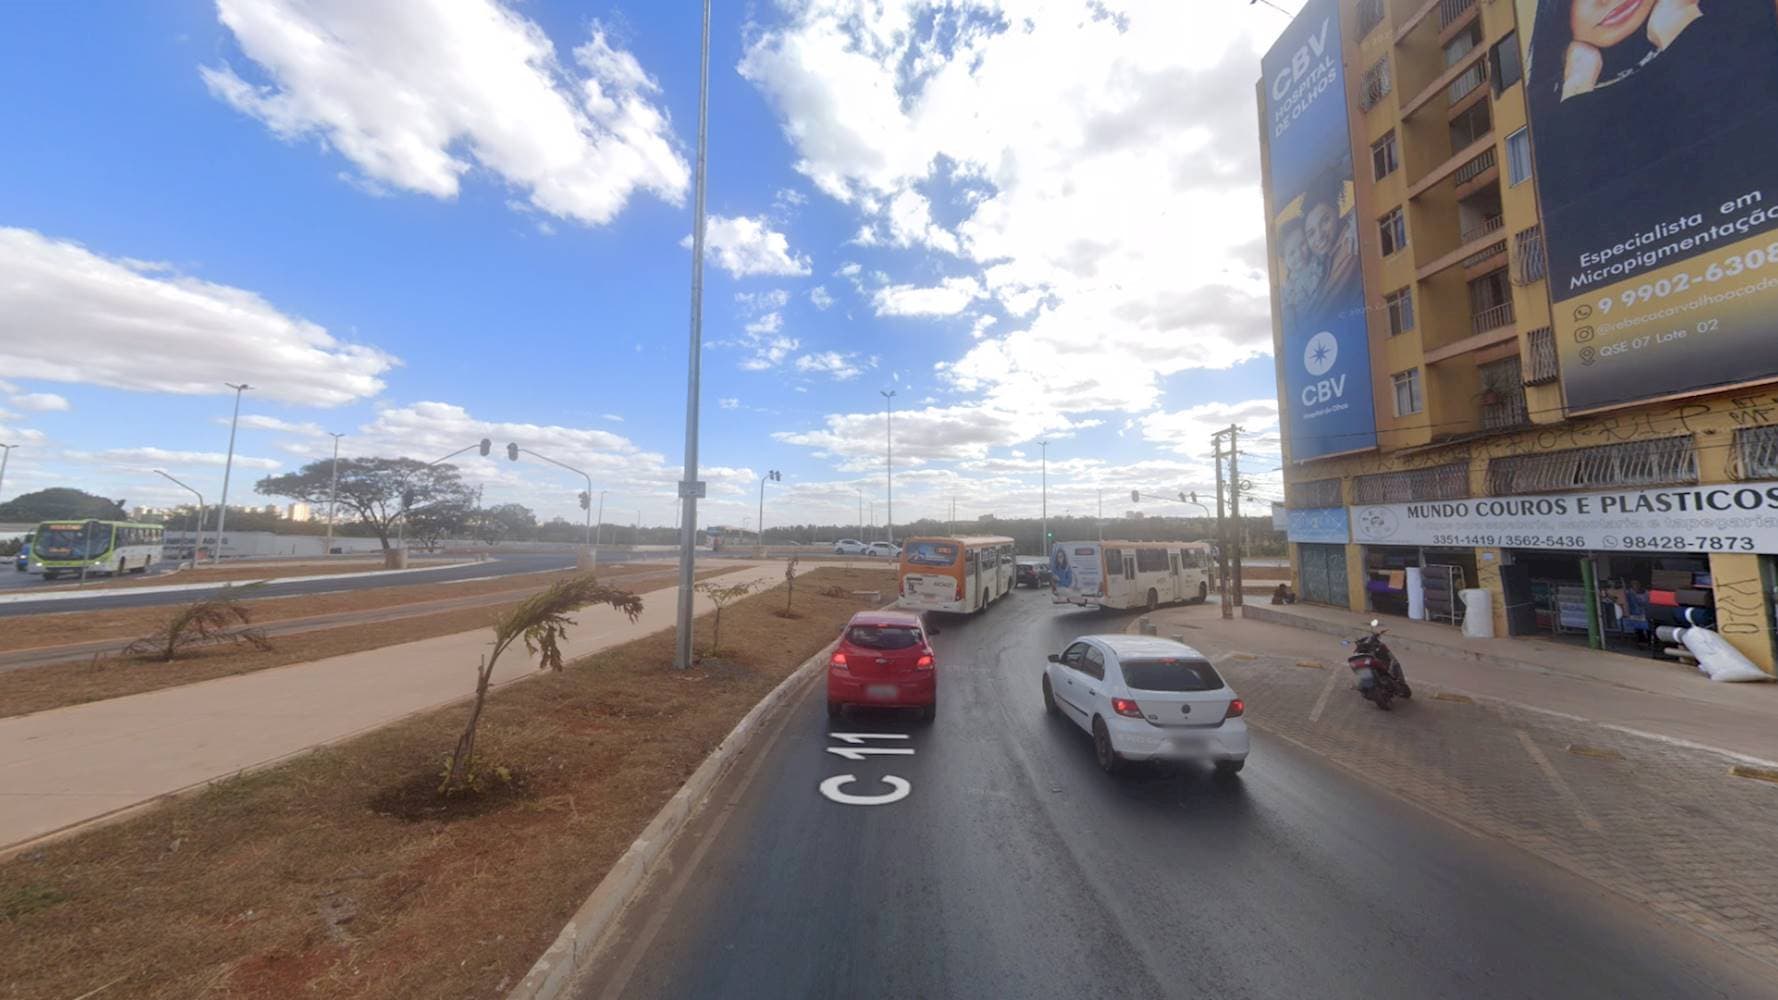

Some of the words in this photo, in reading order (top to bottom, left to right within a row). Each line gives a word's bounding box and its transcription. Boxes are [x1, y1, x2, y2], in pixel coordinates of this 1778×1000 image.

[1272, 16, 1329, 101] CBV
[1275, 55, 1335, 122] HOSPITAL
[1275, 114, 1290, 137] DE
[1292, 67, 1337, 119] OLHOS
[1569, 204, 1778, 290] Micropigmentação
[1580, 212, 1703, 268] Especialista
[1720, 190, 1762, 214] em
[1598, 297, 1613, 315] 9
[1600, 340, 1628, 357] QSE
[1632, 335, 1652, 350] 07
[1656, 328, 1688, 344] Lote
[1697, 318, 1720, 334] 02
[1302, 374, 1346, 406] CBV
[1406, 502, 1469, 520] MUNDO
[1475, 498, 1568, 517] COUROS
[1578, 497, 1591, 514] E
[1600, 487, 1778, 515] PLÁSTICOS
[1432, 534, 1495, 545] 3351-1419
[1505, 535, 1586, 548] 3562-5436
[1622, 536, 1755, 550] 98428-7873
